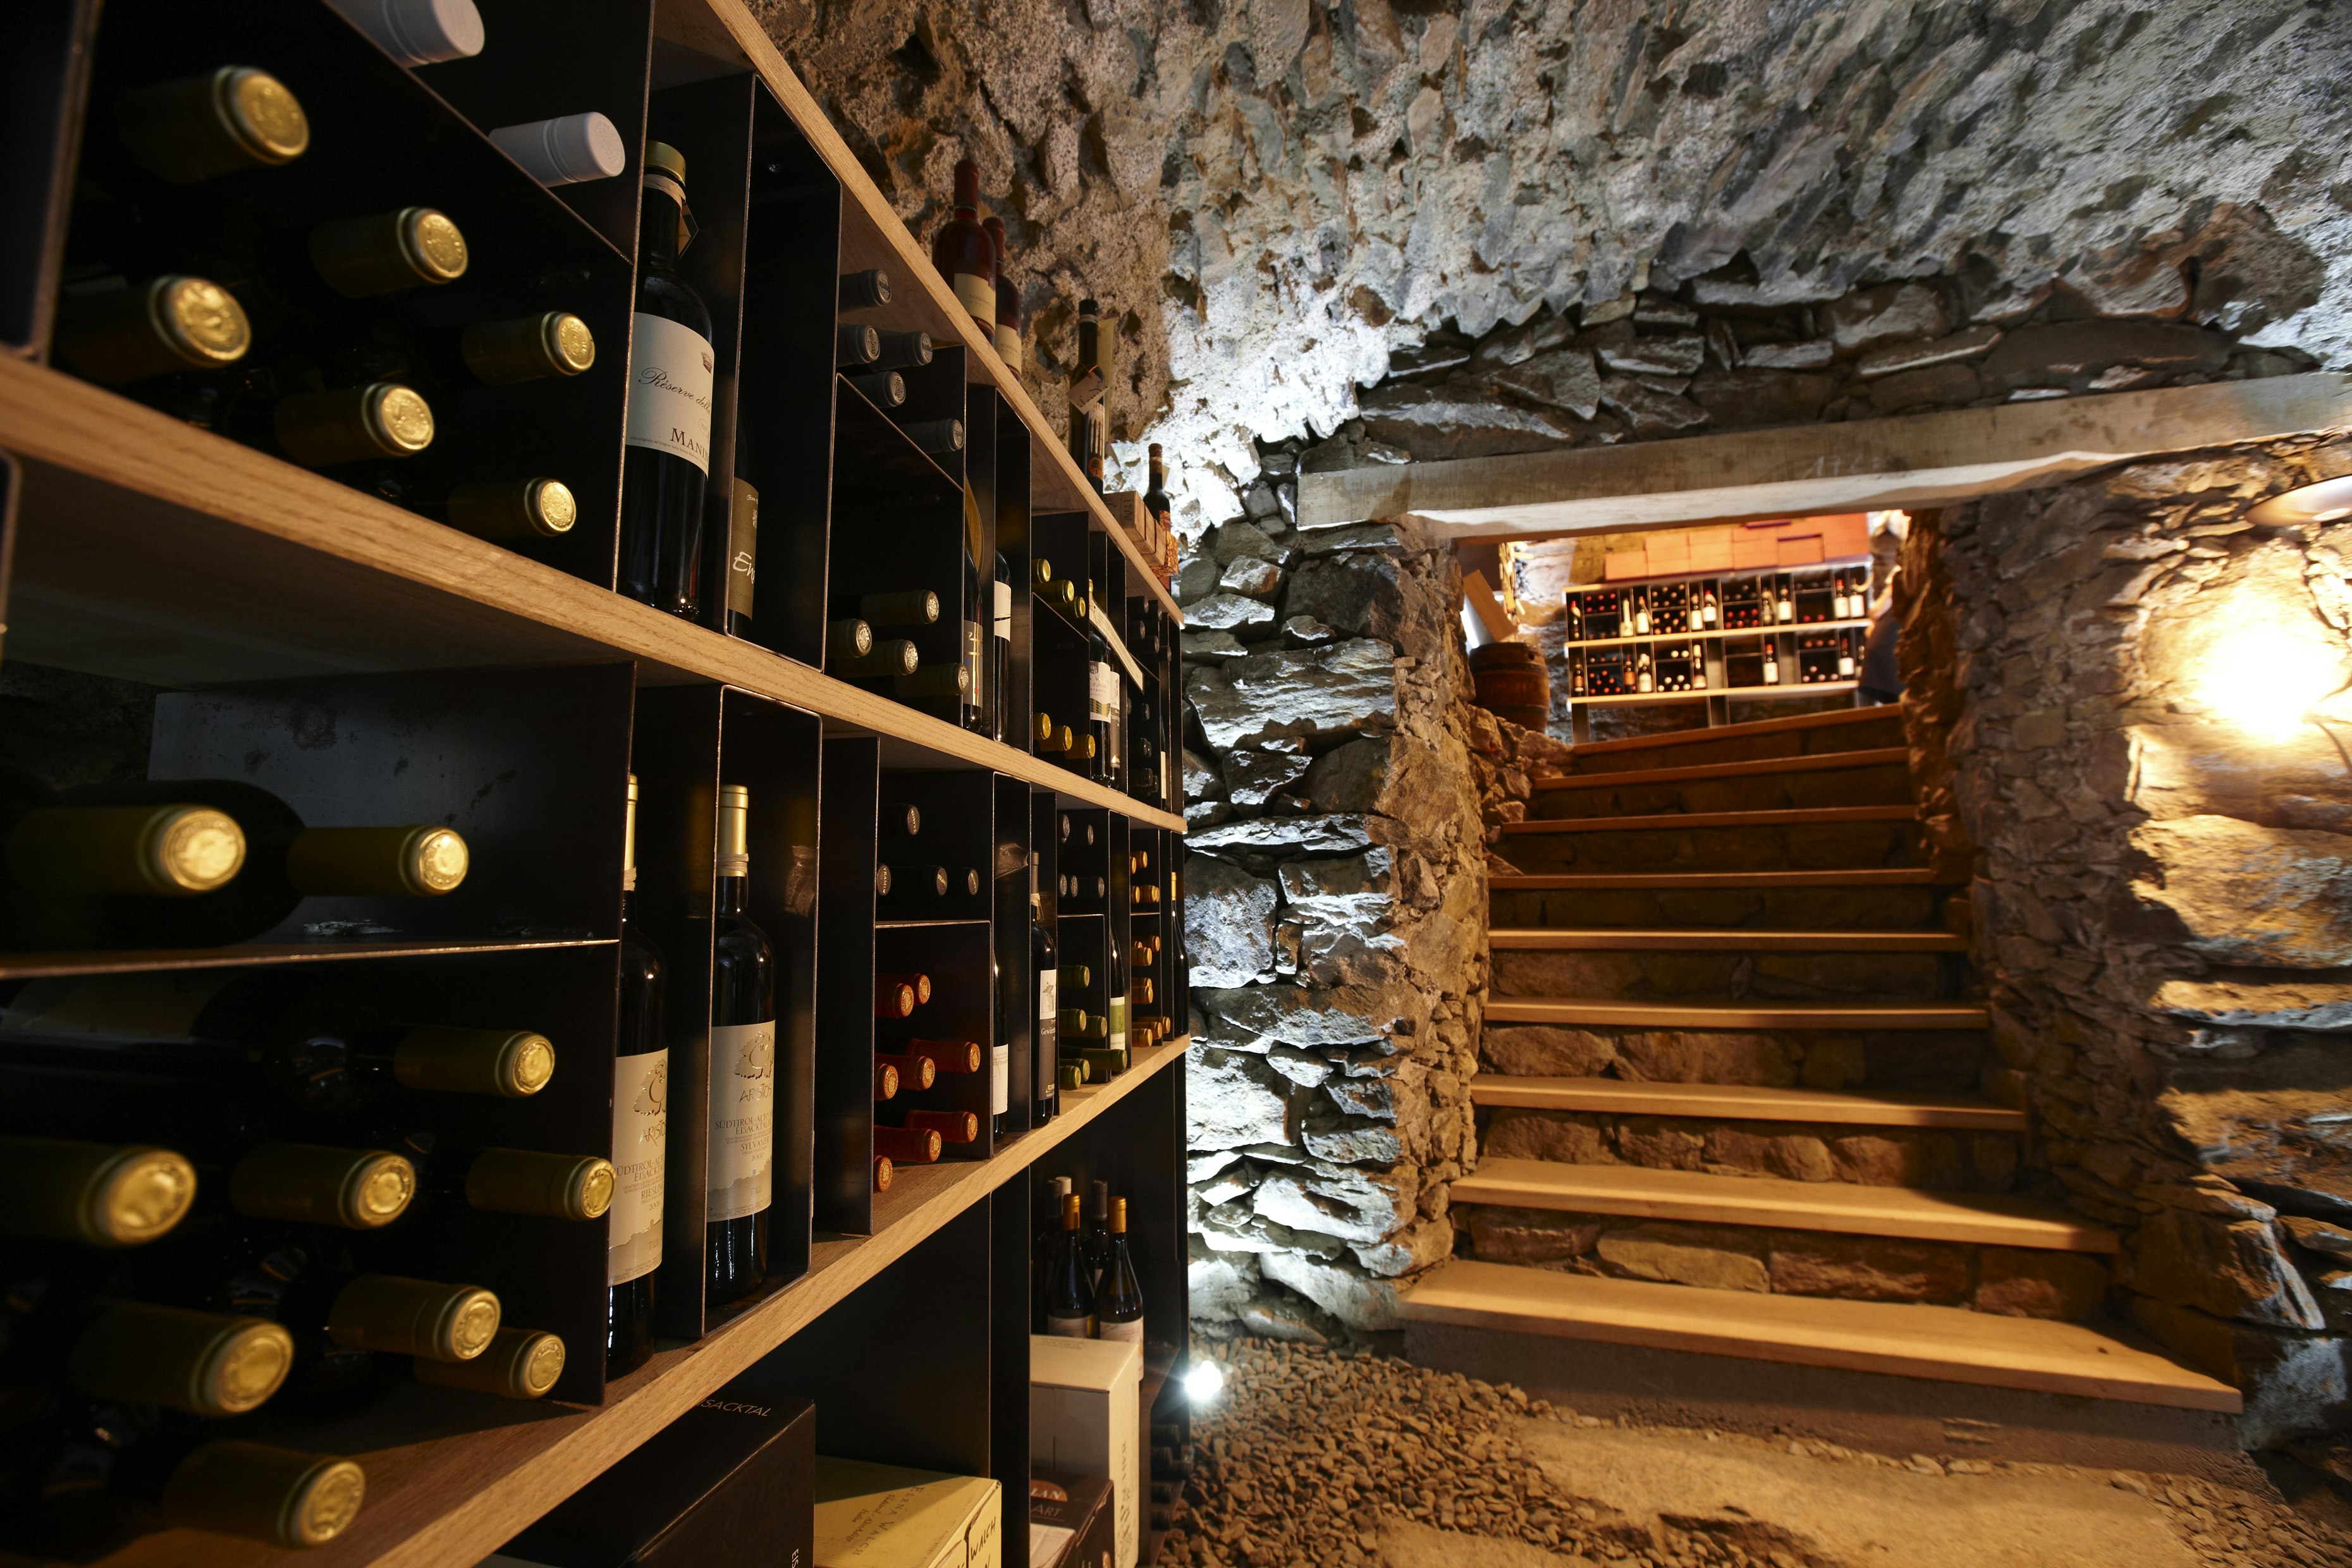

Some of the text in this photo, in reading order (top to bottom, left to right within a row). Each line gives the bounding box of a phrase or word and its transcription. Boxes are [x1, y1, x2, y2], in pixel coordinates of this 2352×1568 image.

[639, 367, 694, 400] Réserve
[739, 1083, 771, 1103] ARSTOS
[741, 1136, 769, 1151] SYLVANER
[853, 1486, 925, 1556] ELENA WALCH
[971, 1516, 996, 1562] WALCH
